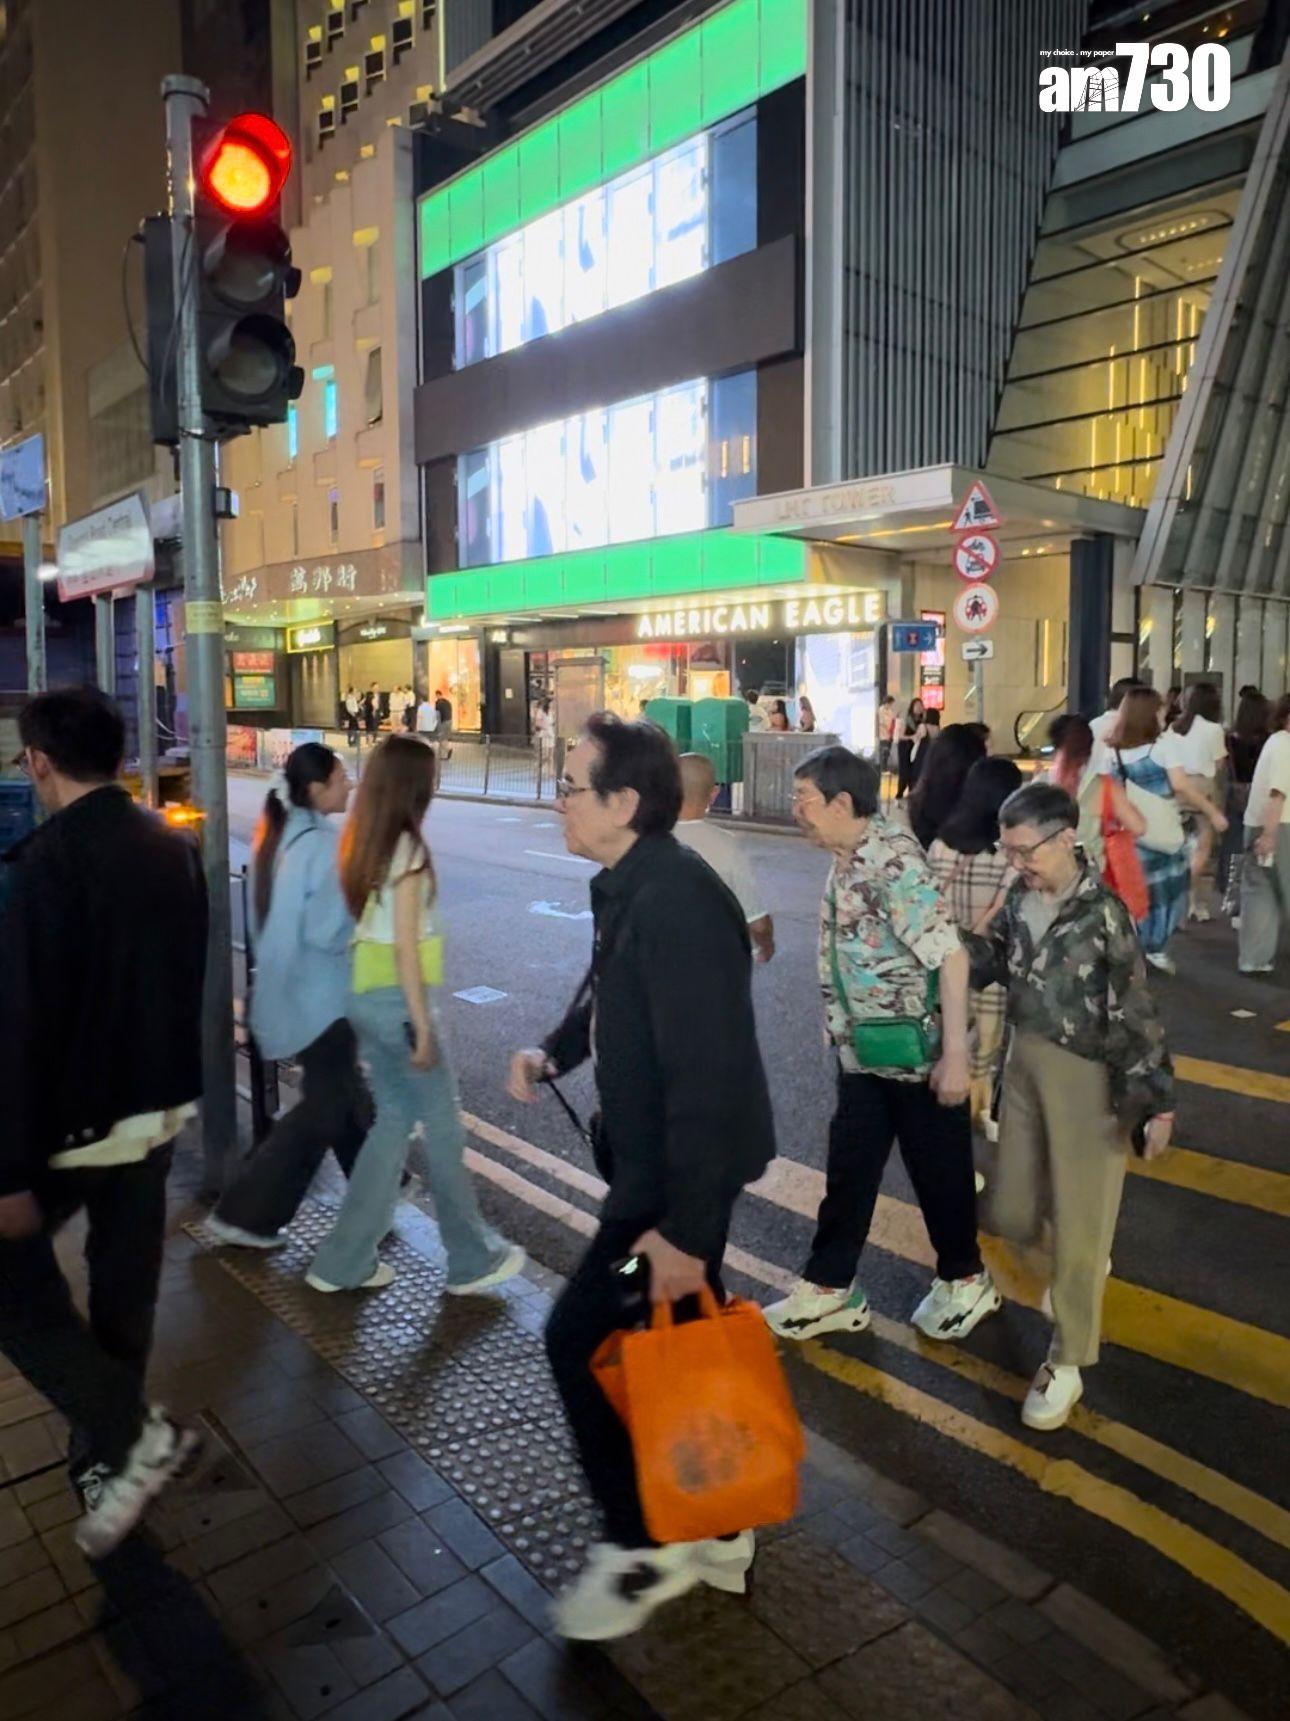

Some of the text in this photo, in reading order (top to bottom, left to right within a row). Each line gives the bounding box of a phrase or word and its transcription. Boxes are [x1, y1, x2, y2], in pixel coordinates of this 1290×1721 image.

[818, 486, 897, 515] TOWER
[637, 593, 881, 638] AMERICAN EAGLE
